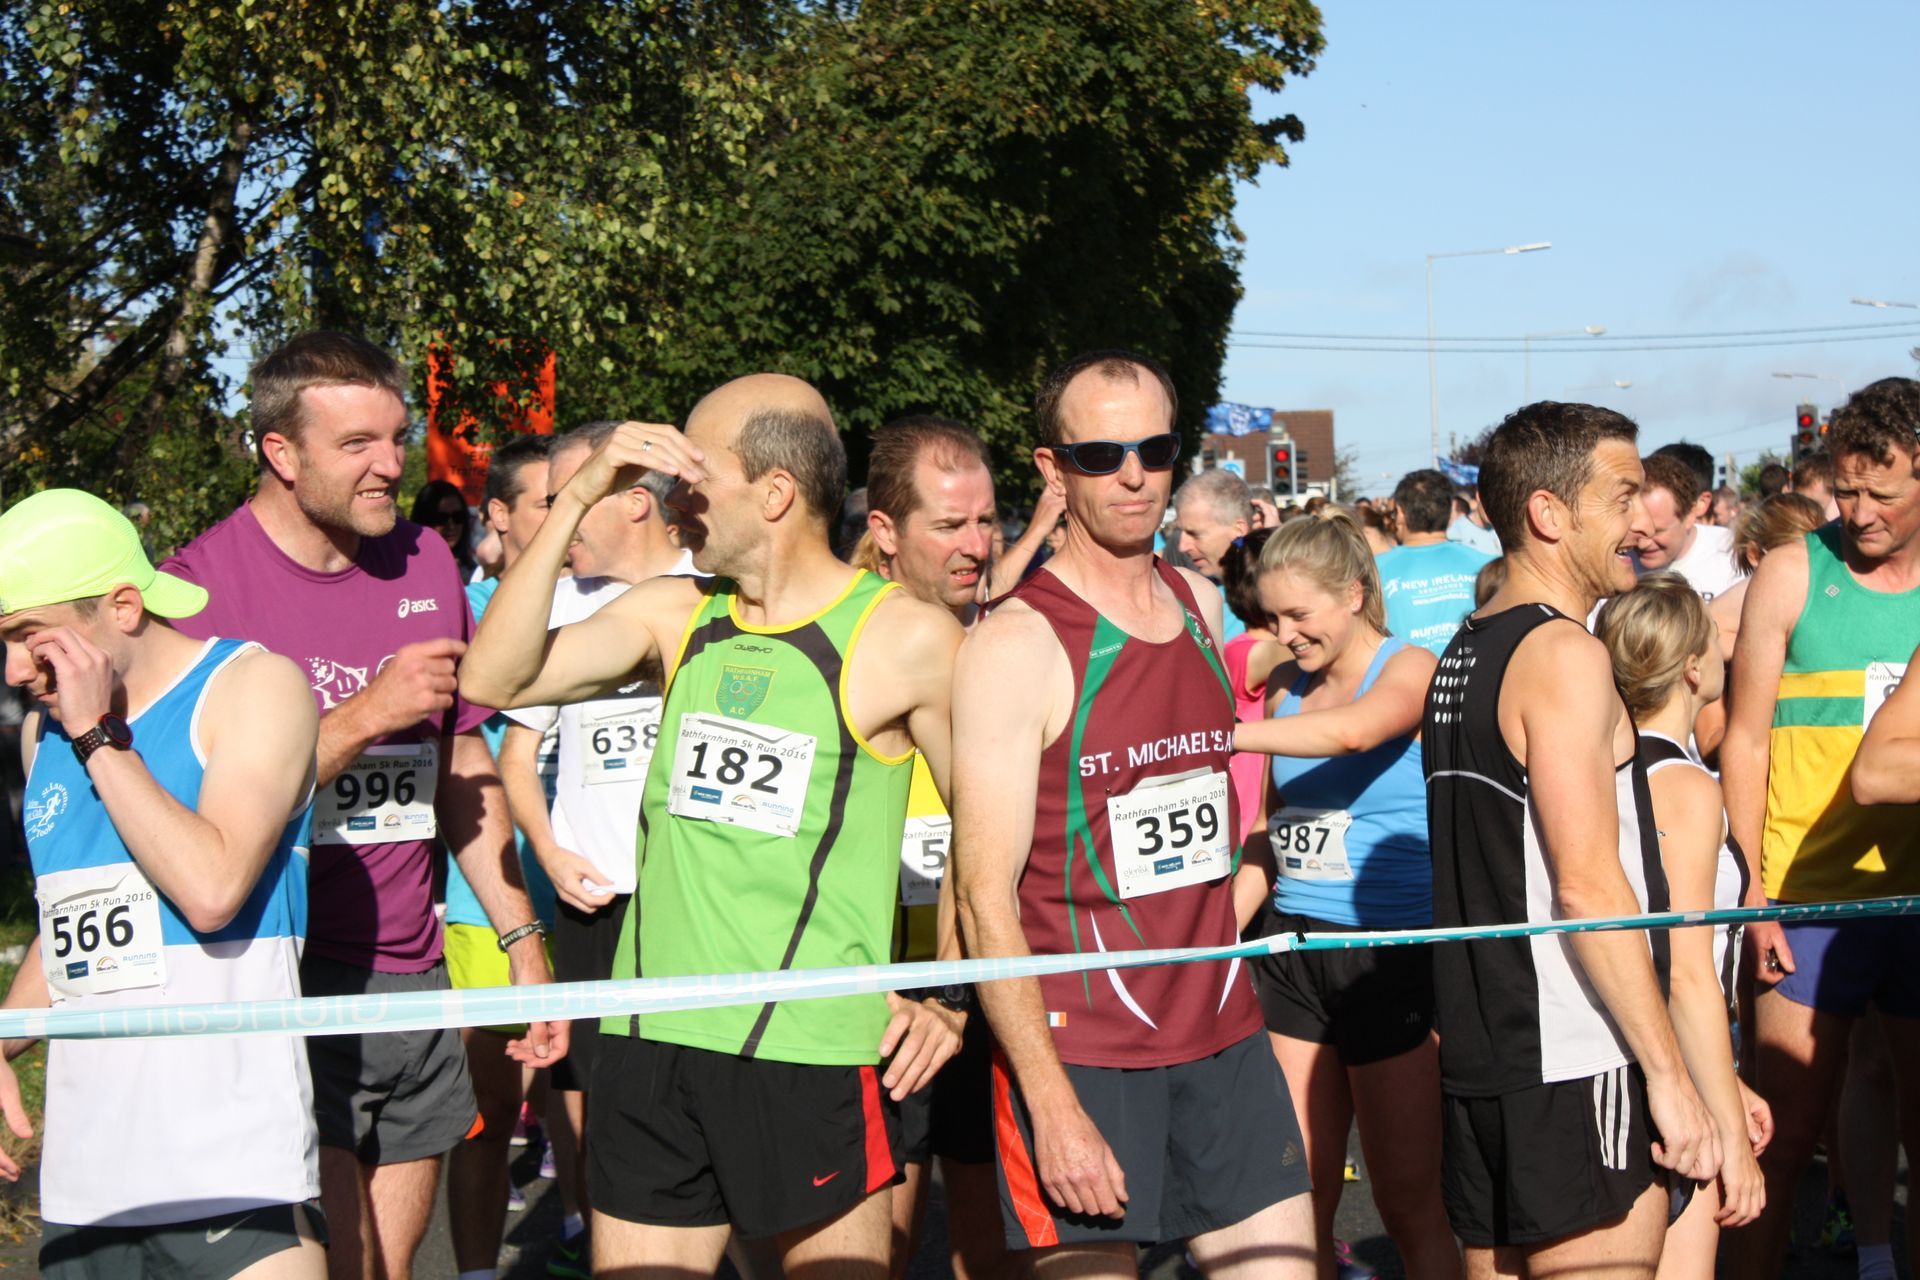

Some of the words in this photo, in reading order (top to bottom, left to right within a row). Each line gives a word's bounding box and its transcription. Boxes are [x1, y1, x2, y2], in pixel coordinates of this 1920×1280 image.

[1401, 578, 1428, 590] NEW
[411, 599, 438, 613] asics
[592, 723, 661, 755] 638
[681, 729, 738, 746] Rathfarnham
[741, 740, 753, 749] 5k
[756, 743, 777, 754] Run
[780, 748, 807, 760] 2016
[1079, 752, 1119, 777] ST.
[1128, 730, 1224, 768] MICHAEL'S
[412, 758, 433, 768] 2016
[686, 741, 783, 795] 182
[335, 770, 416, 811] 996
[1114, 802, 1177, 822] Rathfarnham
[1179, 797, 1190, 807] 5k
[1191, 793, 1208, 805] Run
[1209, 788, 1226, 800] 2016
[1136, 802, 1219, 856] 359
[1277, 823, 1330, 855] 987
[922, 838, 946, 871] 5
[90, 899, 100, 909] 5k
[103, 897, 121, 907] Run
[125, 891, 152, 903] 2016
[53, 904, 134, 958] 566
